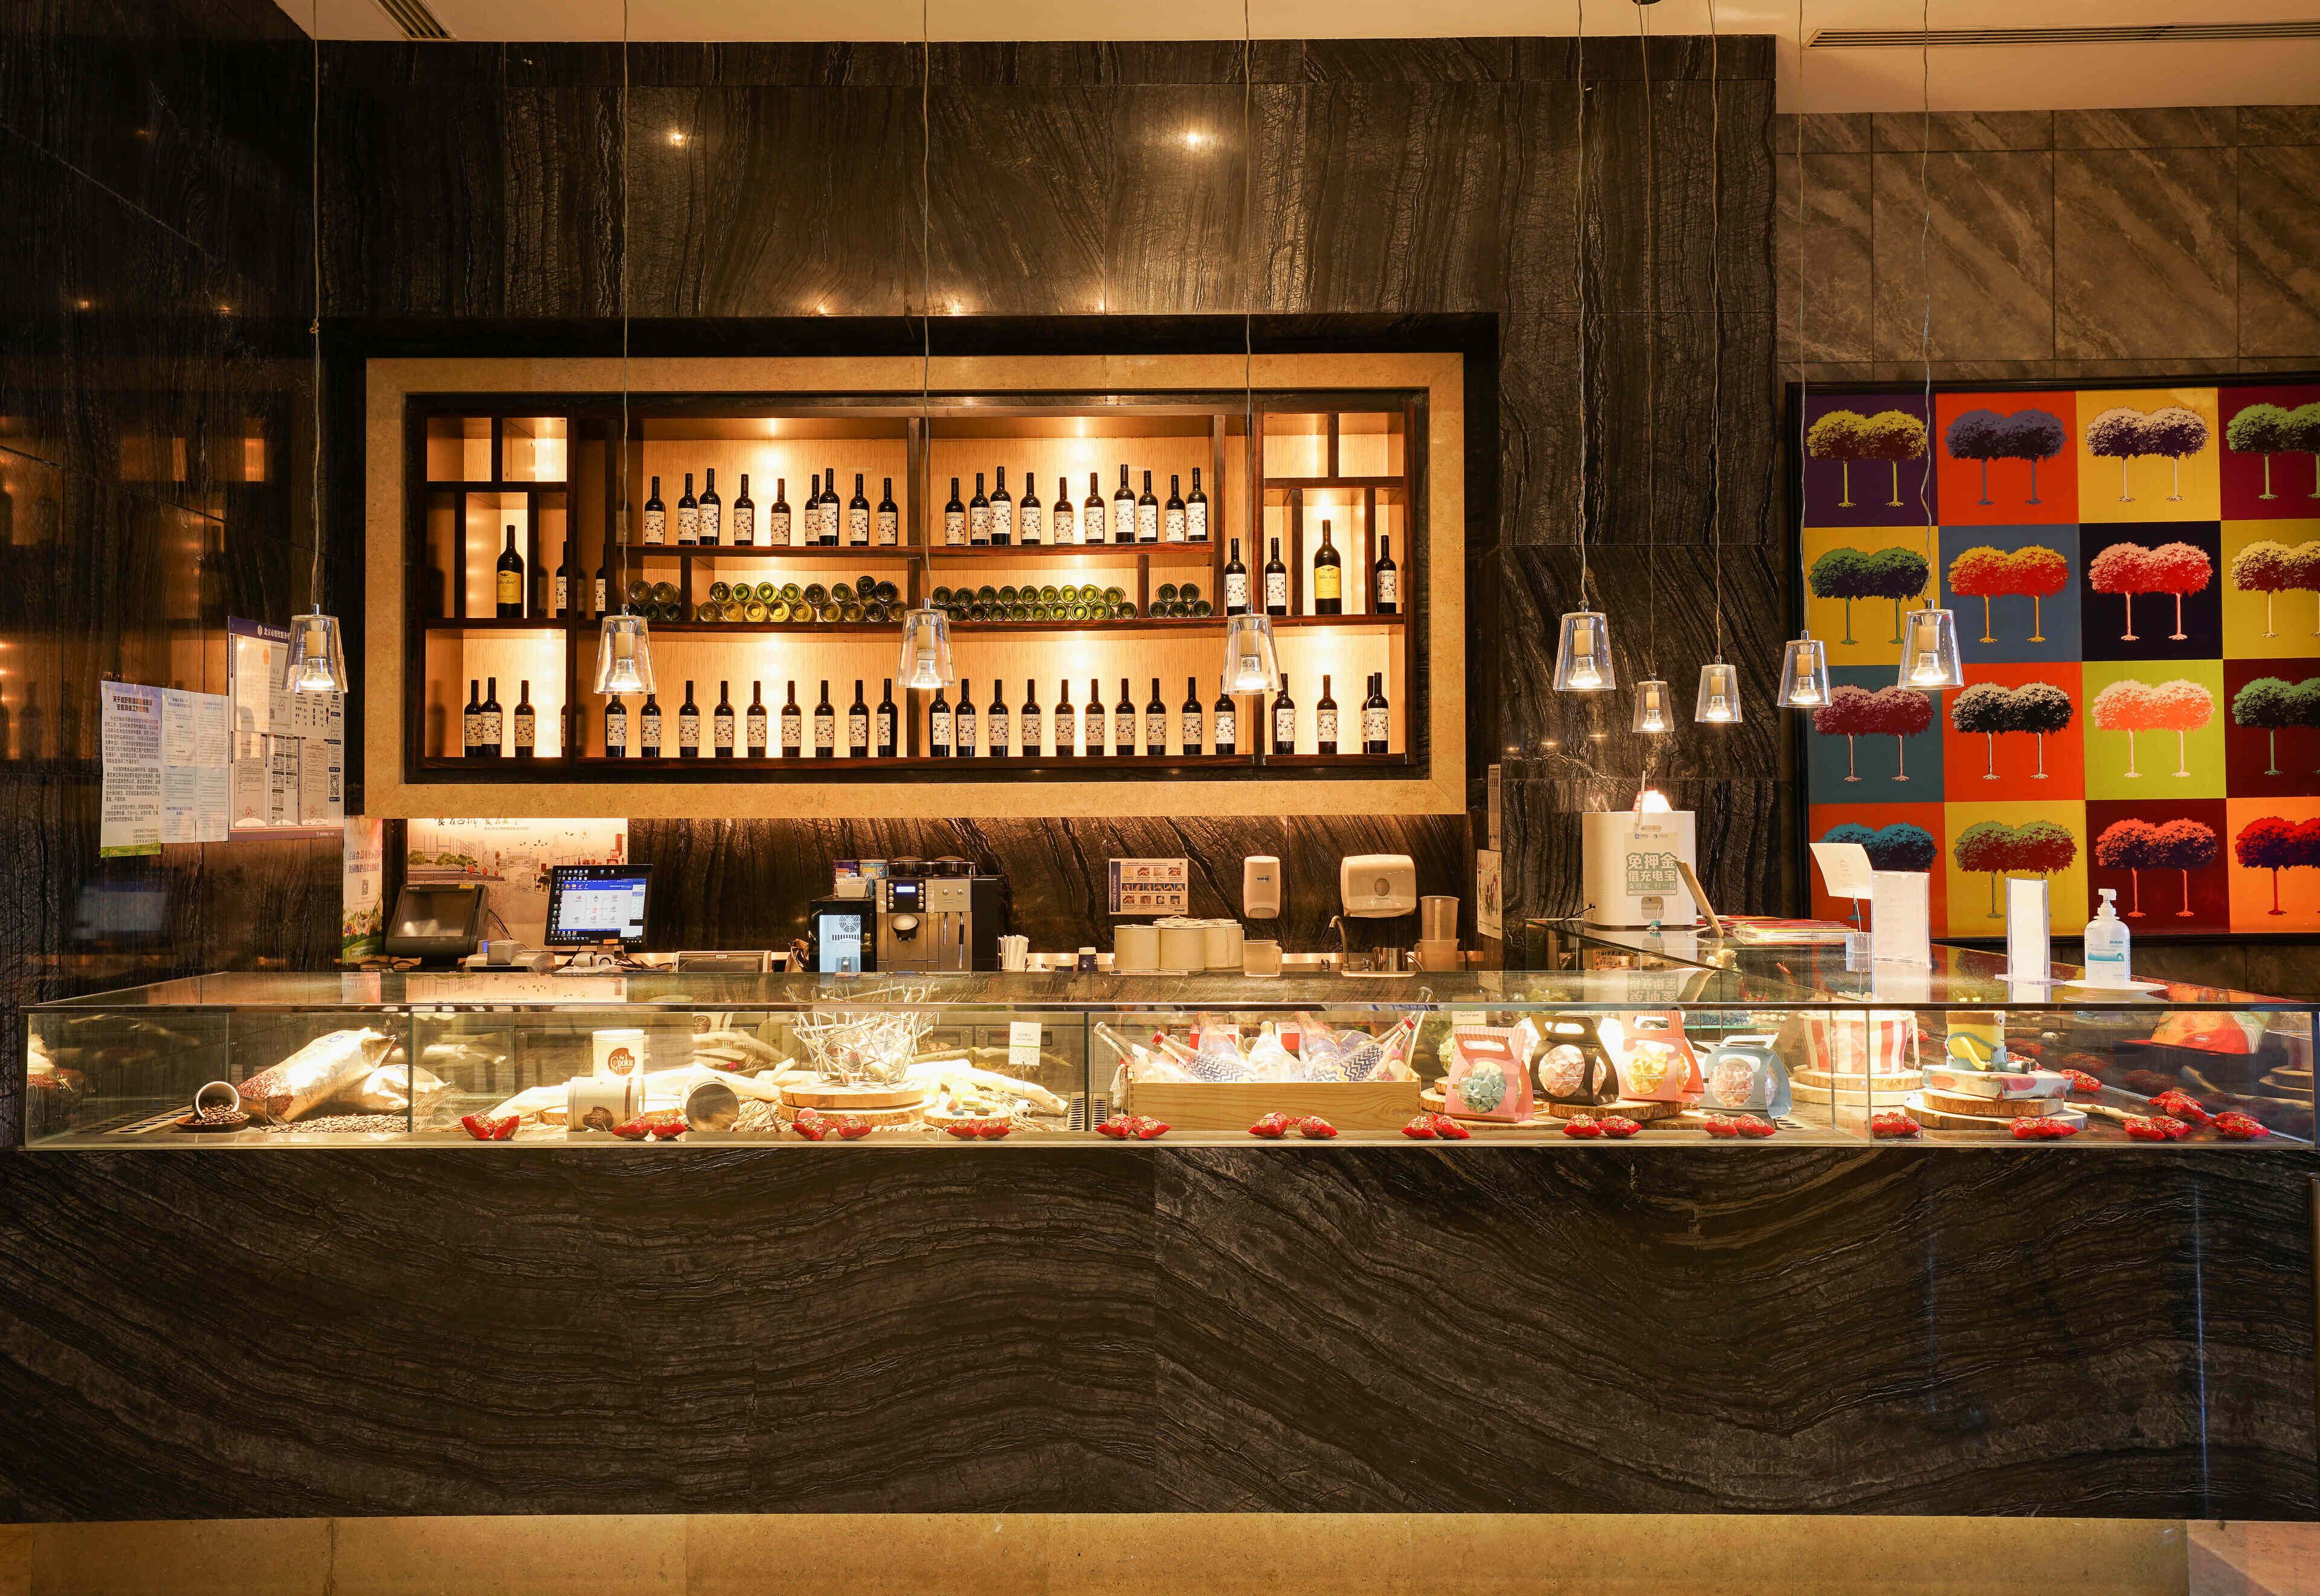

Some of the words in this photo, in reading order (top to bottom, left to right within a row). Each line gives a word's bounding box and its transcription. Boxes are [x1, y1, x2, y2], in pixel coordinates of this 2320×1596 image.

[1628, 854, 1675, 869] 免押金
[1628, 870, 1676, 881] 借充电宝
[610, 1056, 634, 1070] Cookie
